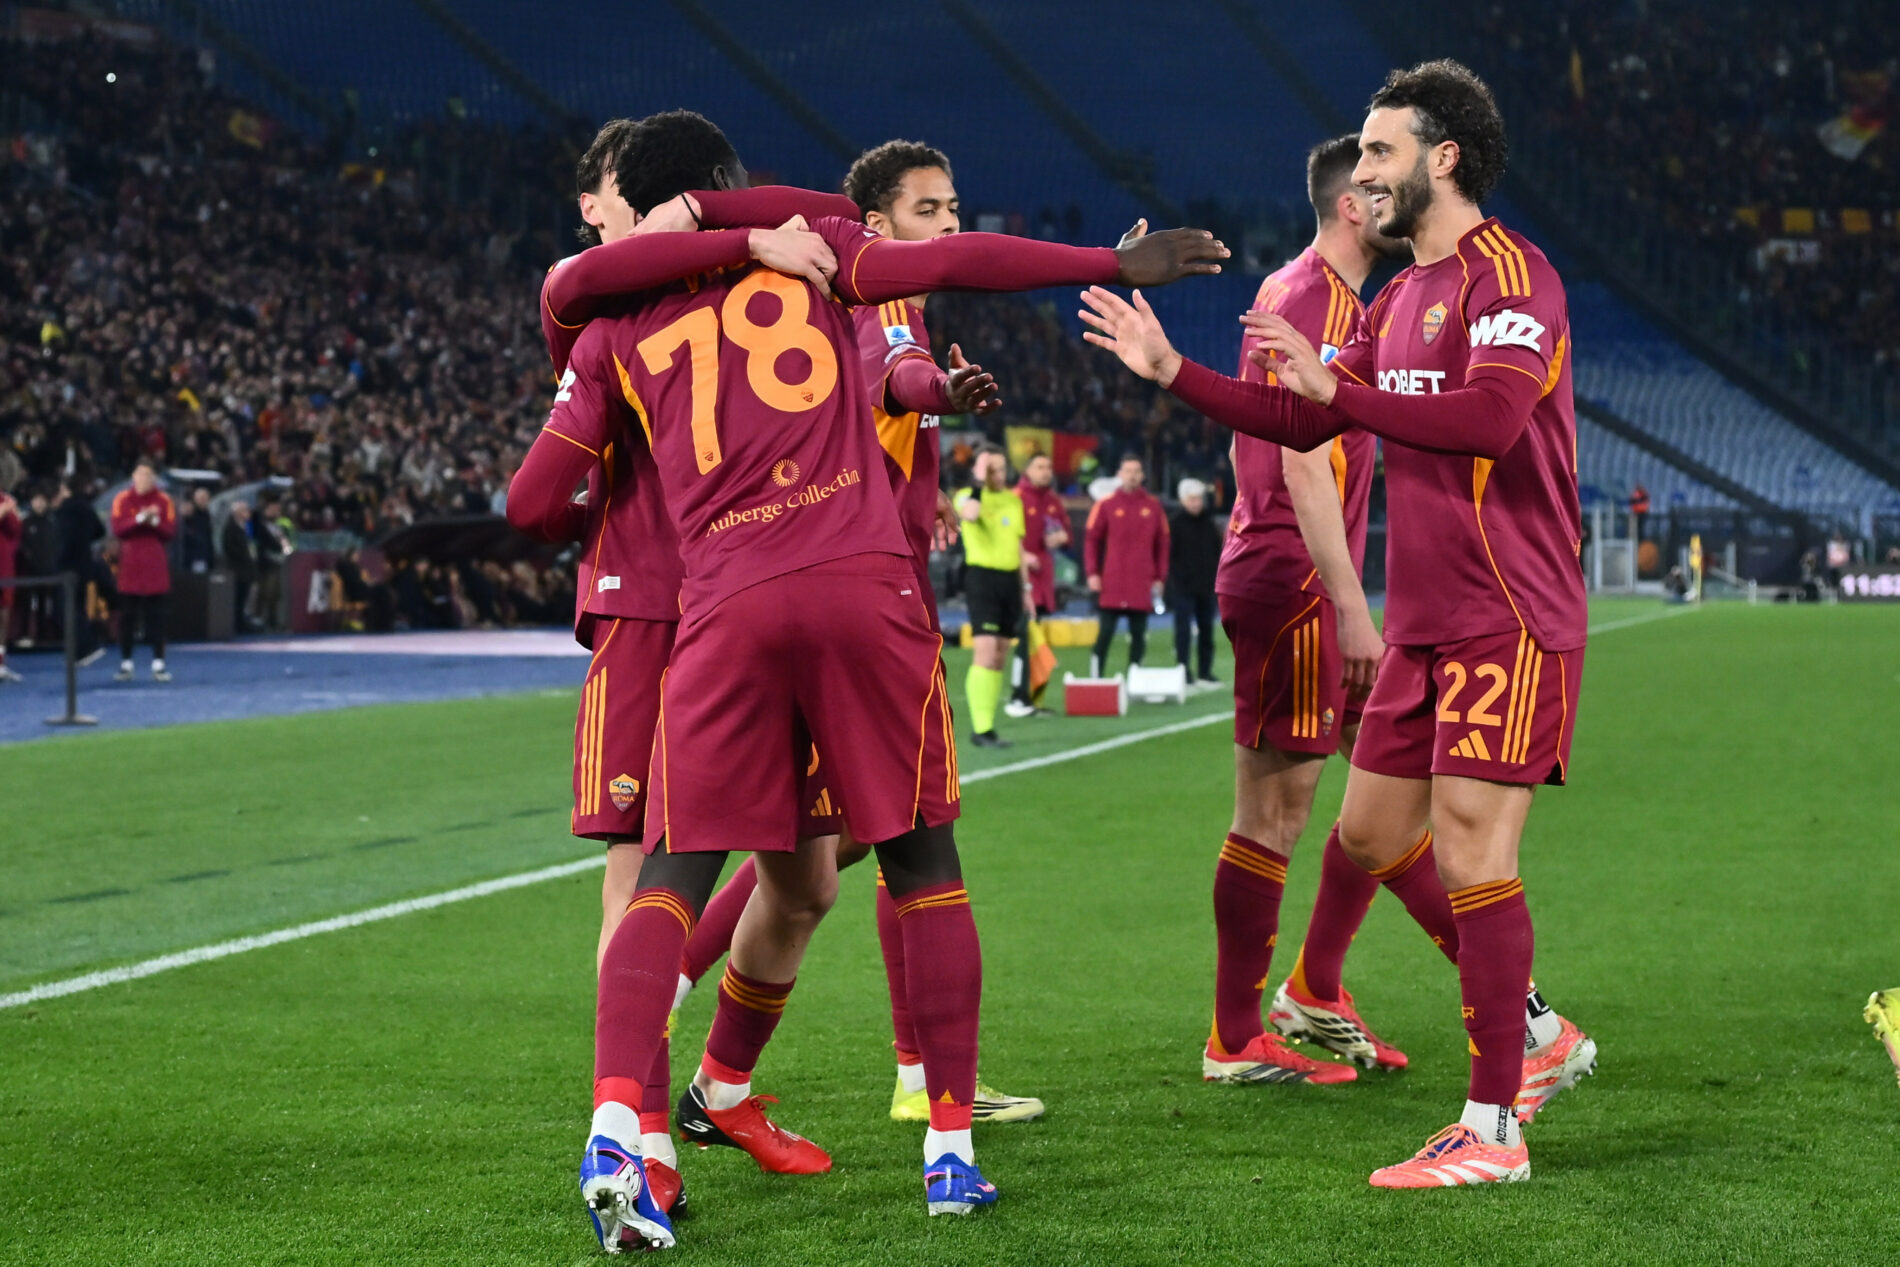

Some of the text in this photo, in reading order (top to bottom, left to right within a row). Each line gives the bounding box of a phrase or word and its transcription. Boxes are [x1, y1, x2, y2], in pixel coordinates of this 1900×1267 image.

[637, 268, 838, 475] 78
[705, 468, 861, 538] Auberge Collectin
[1438, 661, 1508, 727] 22
